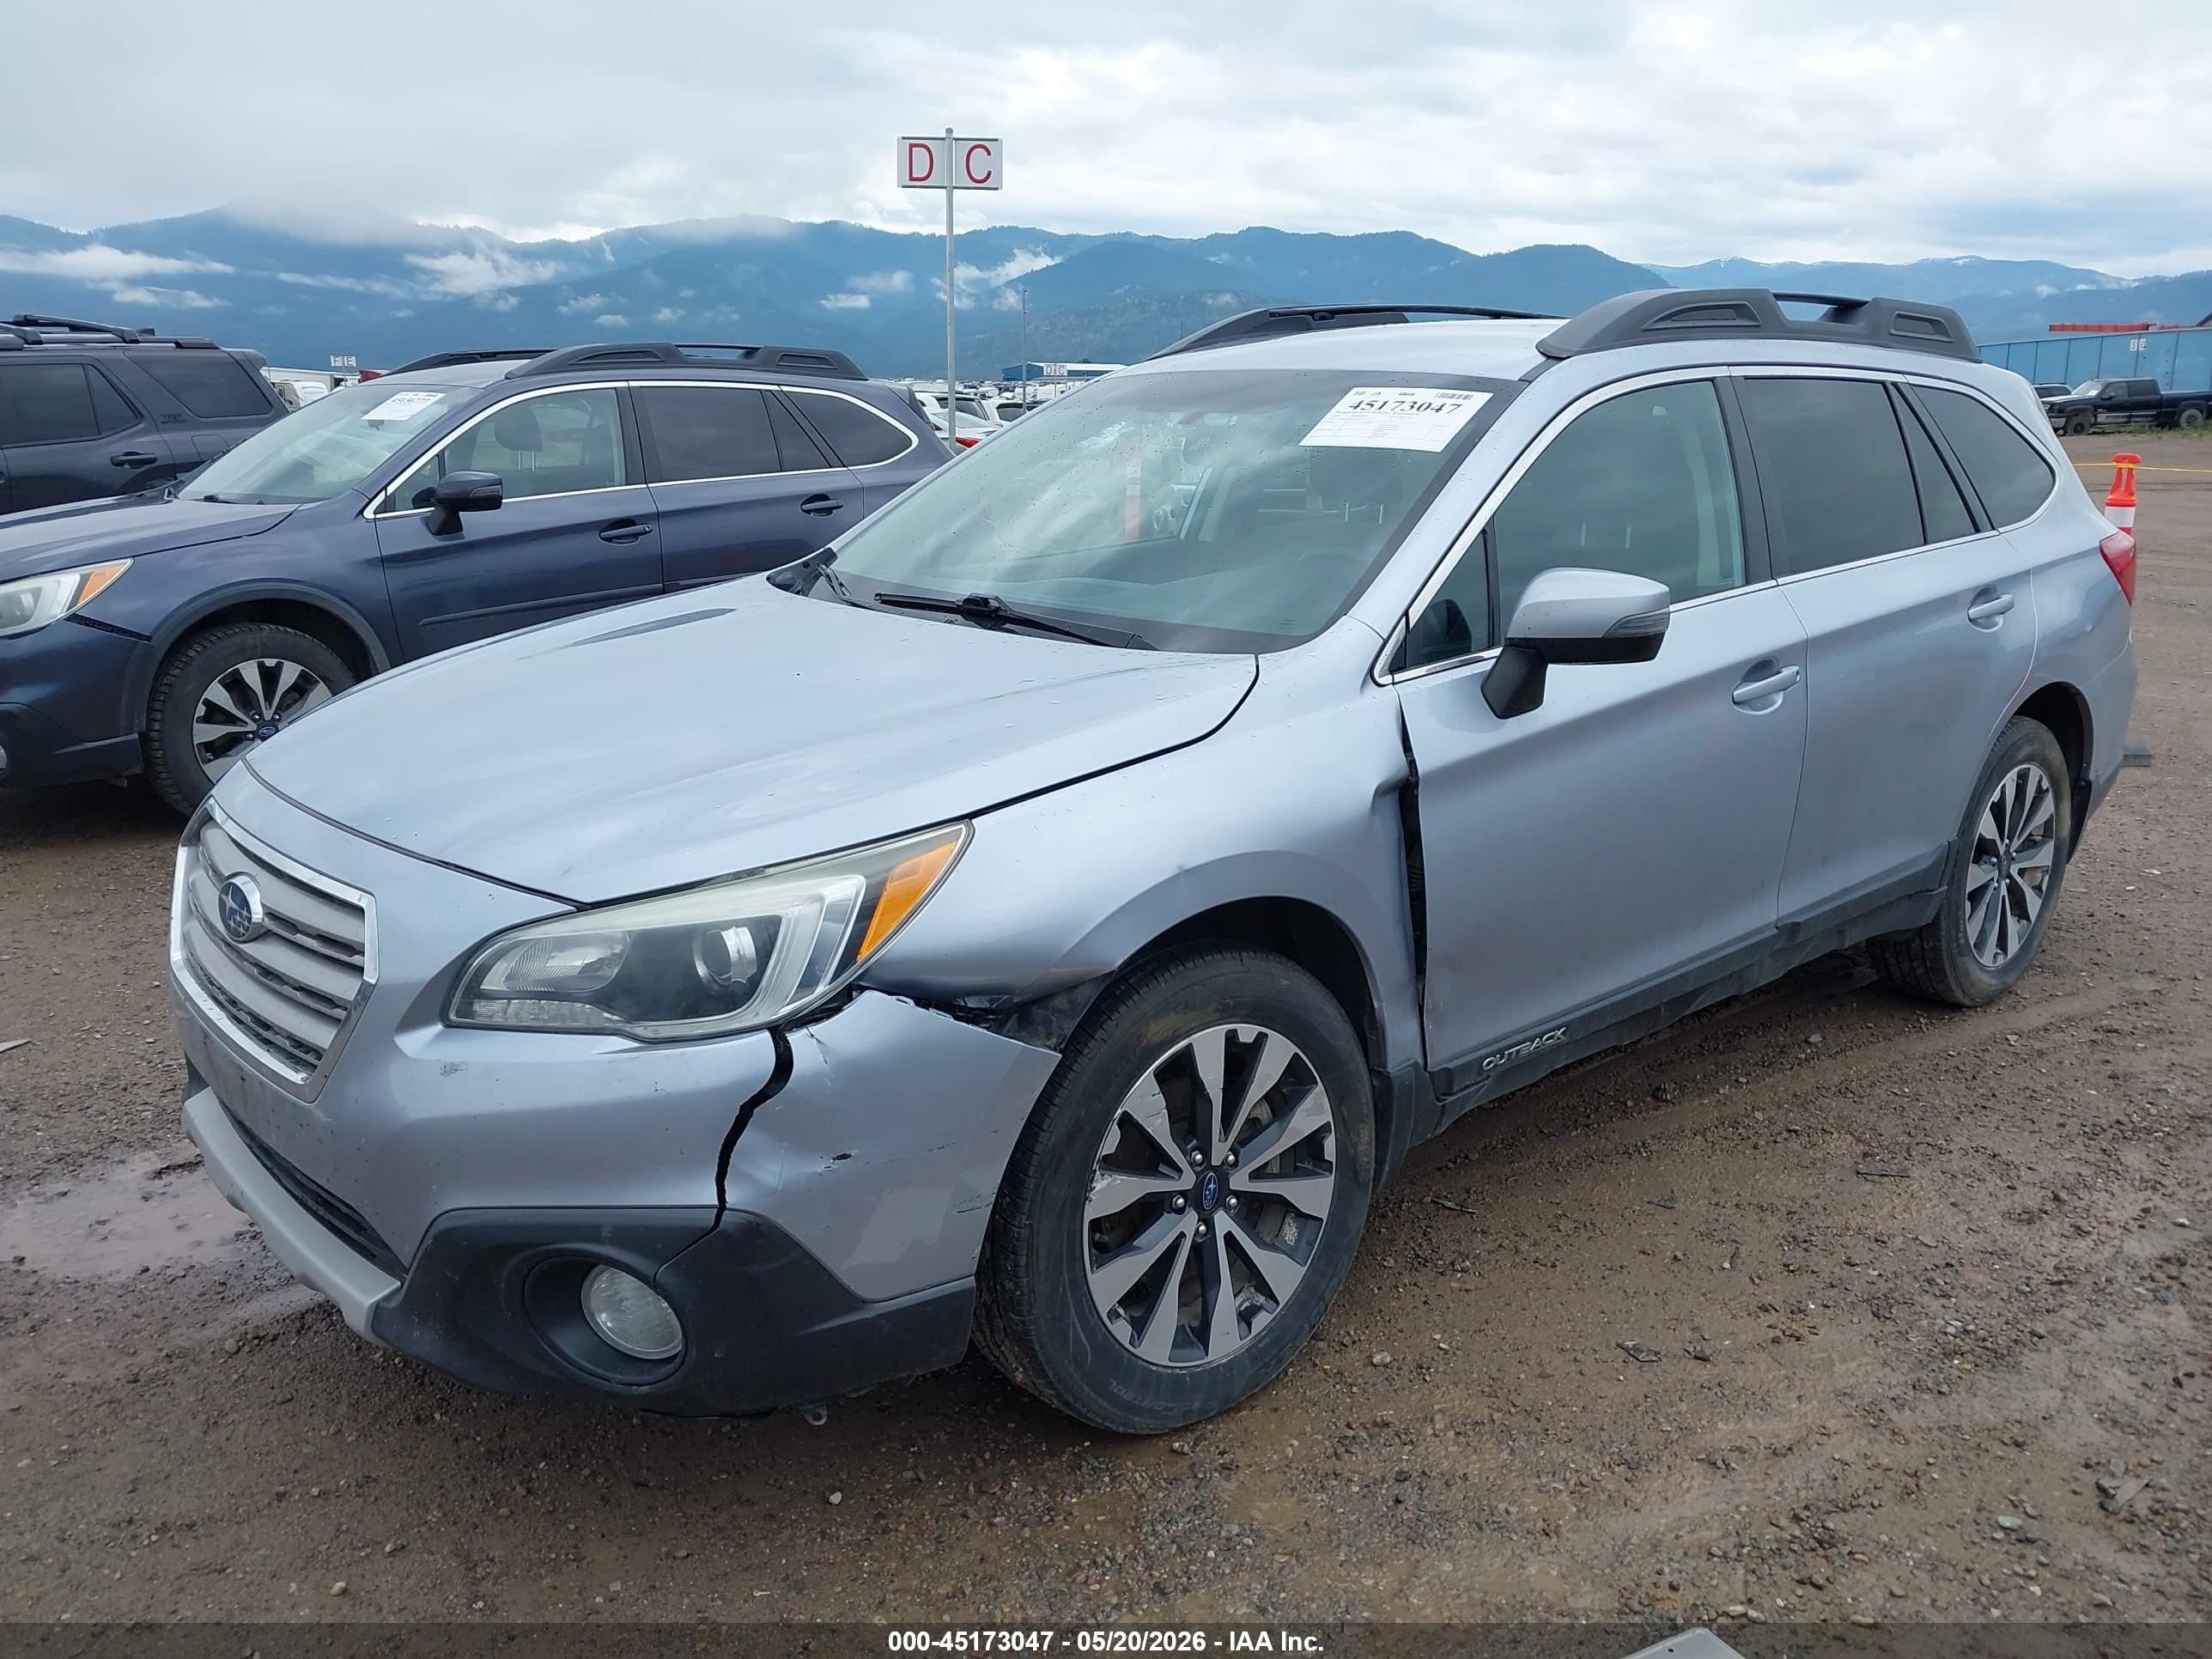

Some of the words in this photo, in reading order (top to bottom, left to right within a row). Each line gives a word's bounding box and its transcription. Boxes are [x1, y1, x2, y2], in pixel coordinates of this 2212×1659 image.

[908, 143, 934, 182] D
[965, 143, 993, 185] C
[1046, 365, 1053, 375] D
[1058, 365, 1065, 375] C
[1348, 399, 1463, 415] 45173047
[1482, 1026, 1567, 1072] OUTBACK
